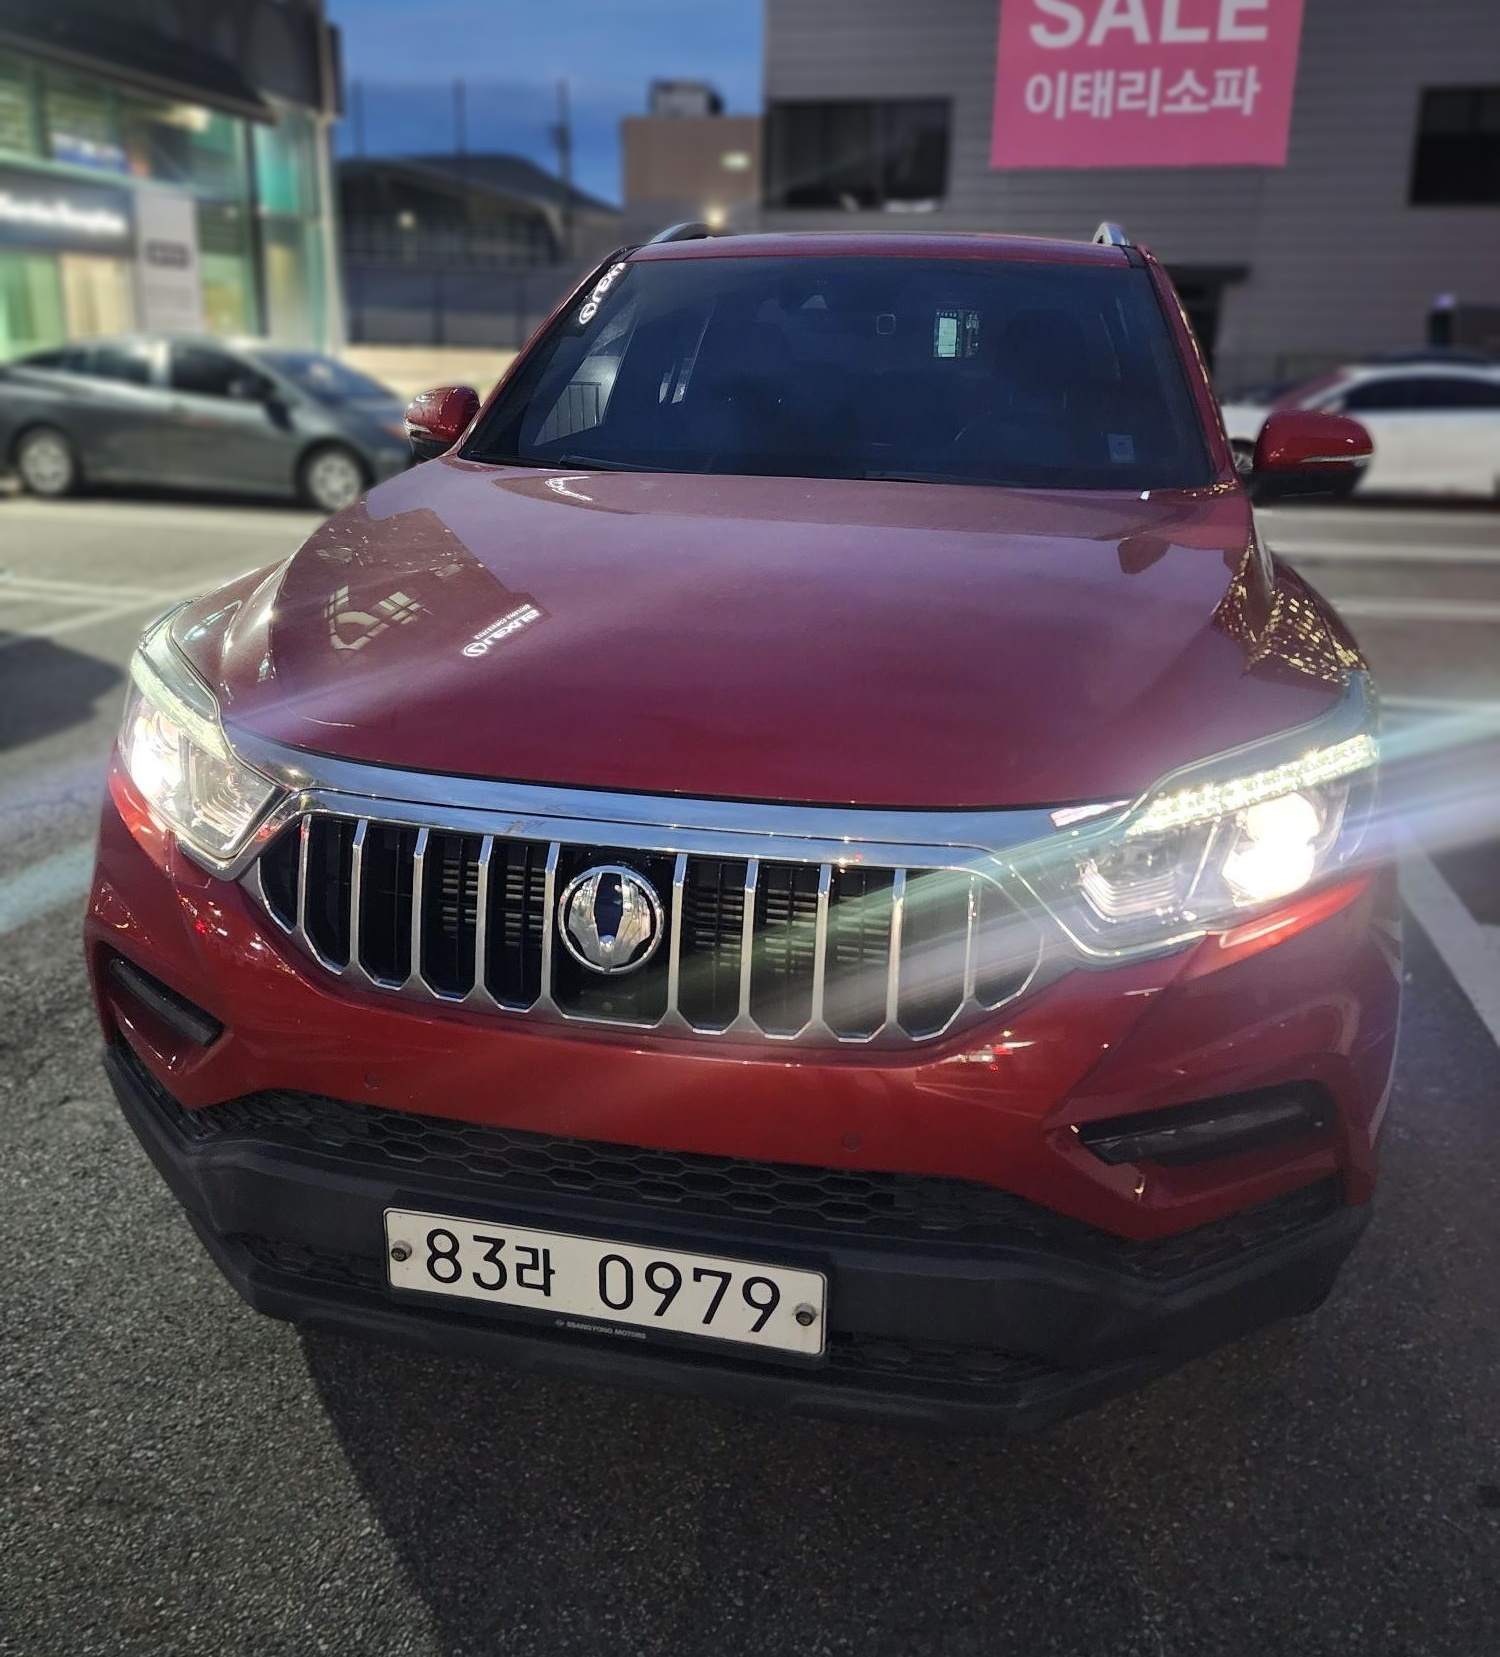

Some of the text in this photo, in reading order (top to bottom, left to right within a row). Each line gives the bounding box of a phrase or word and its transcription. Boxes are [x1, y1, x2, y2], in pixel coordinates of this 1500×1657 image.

[1029, 0, 1268, 48] SALE
[1025, 66, 1261, 119] 이태리소파
[426, 1228, 781, 1333] 83라 0979
